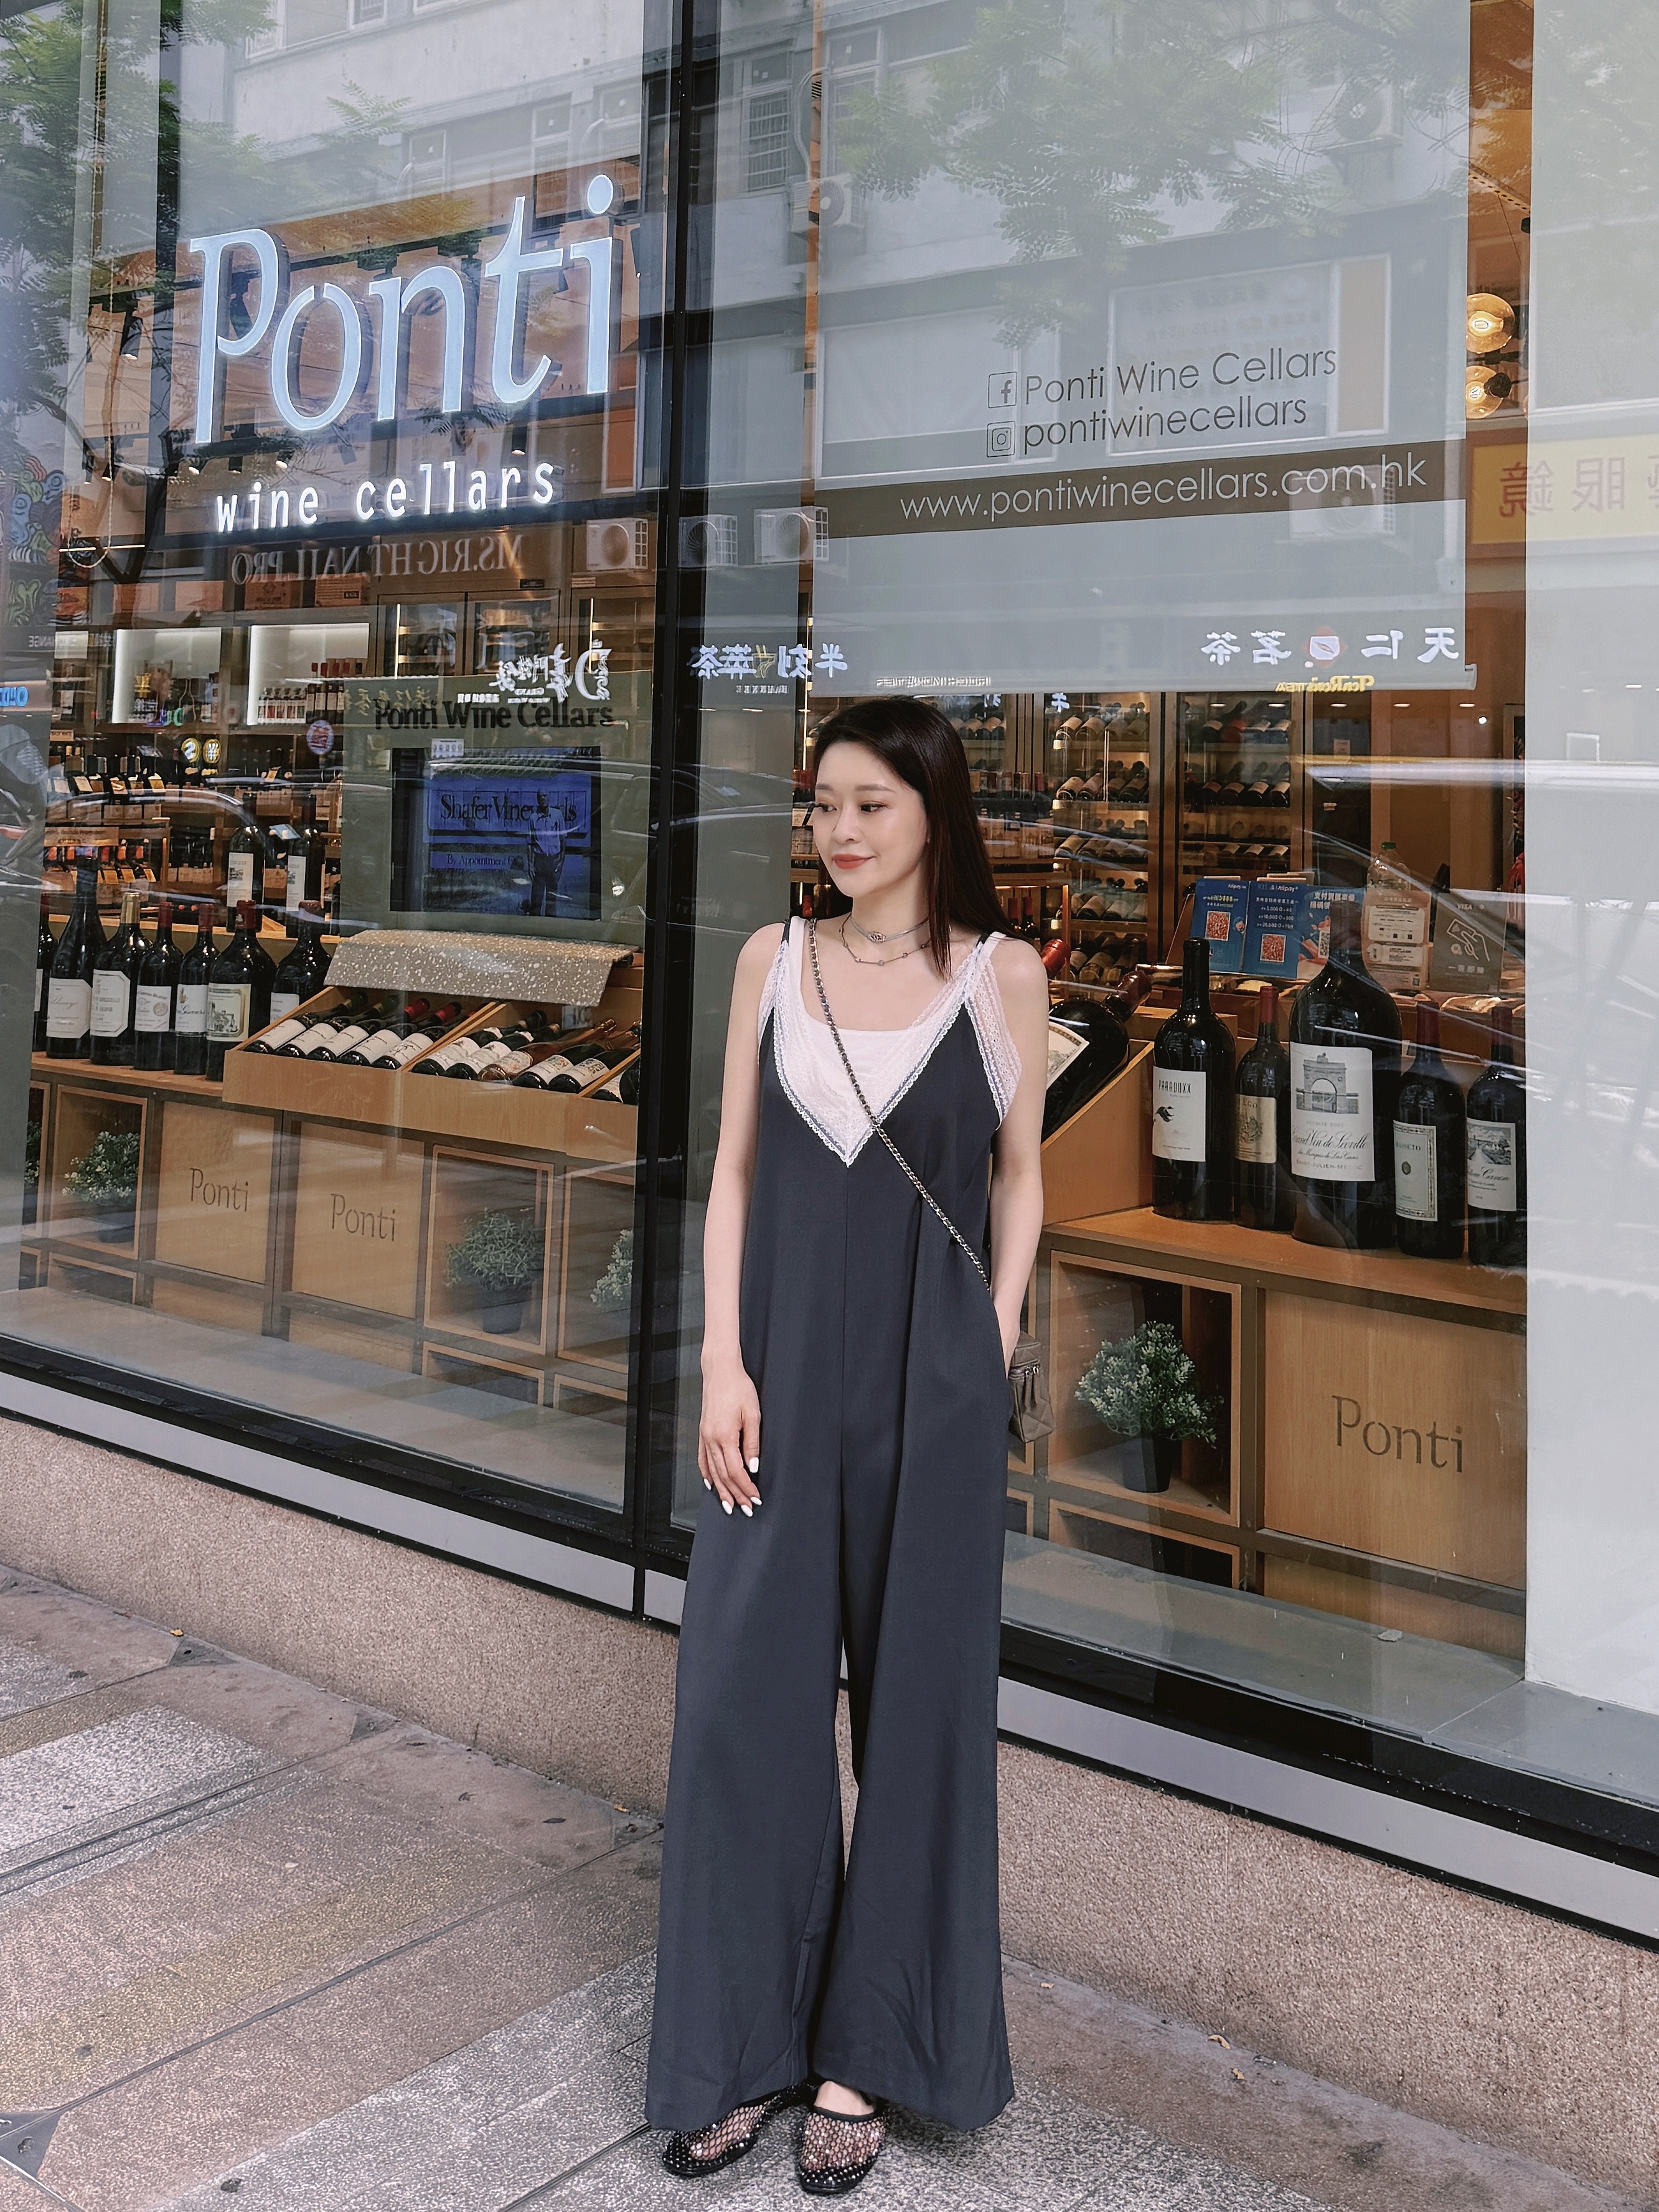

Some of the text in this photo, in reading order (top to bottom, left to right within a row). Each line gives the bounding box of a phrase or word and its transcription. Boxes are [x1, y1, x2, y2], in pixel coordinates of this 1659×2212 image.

[189, 174, 616, 445] Ponti
[1025, 347, 1337, 405] Ponti Wine Cellars
[1023, 395, 1307, 454] pontiwinecellars
[216, 459, 556, 534] wine cellars
[900, 452, 1427, 522] www.pontiwinecellars.com.hk
[374, 699, 437, 730] Ponti
[443, 701, 512, 729] Wine
[517, 697, 614, 728] Cellars
[441, 793, 491, 821] Shafer
[190, 1167, 249, 1212] Ponti
[331, 1193, 396, 1241] Ponti
[1332, 1395, 1464, 1473] Ponti
